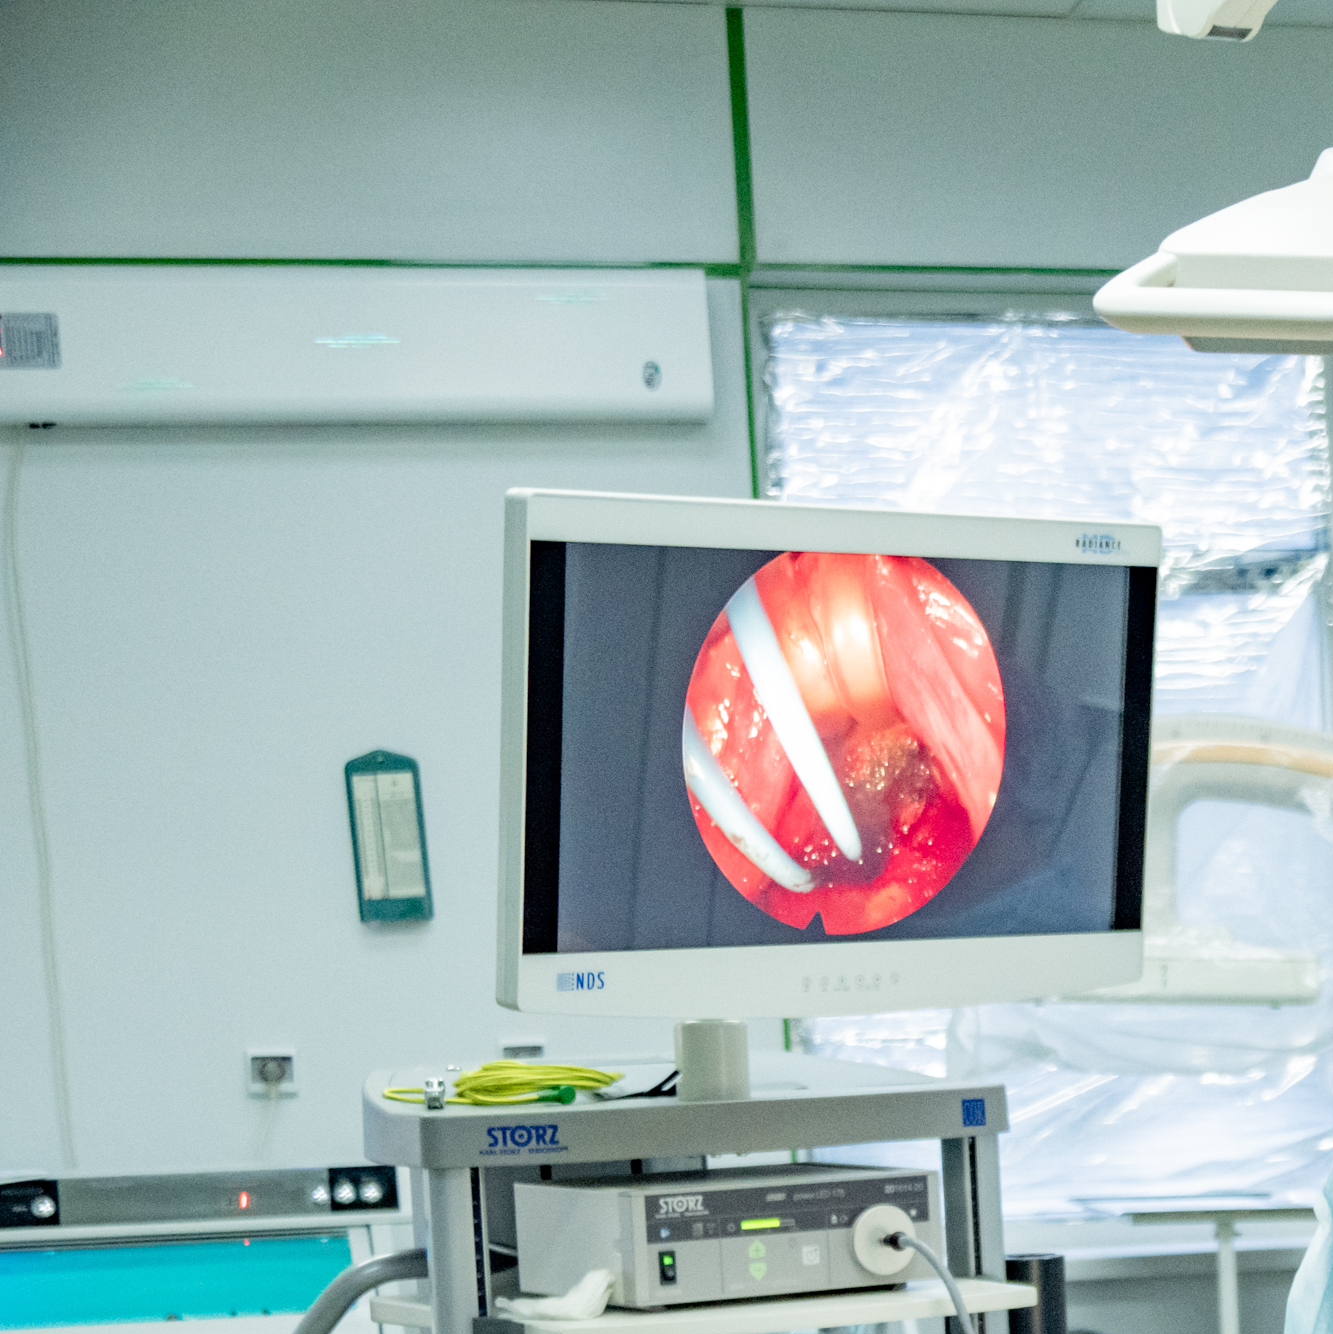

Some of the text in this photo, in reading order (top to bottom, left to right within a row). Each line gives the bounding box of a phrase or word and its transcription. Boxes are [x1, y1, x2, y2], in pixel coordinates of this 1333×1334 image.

[576, 971, 605, 990] NDS
[487, 1124, 560, 1148] STORZ
[658, 1195, 704, 1214] STORZ
